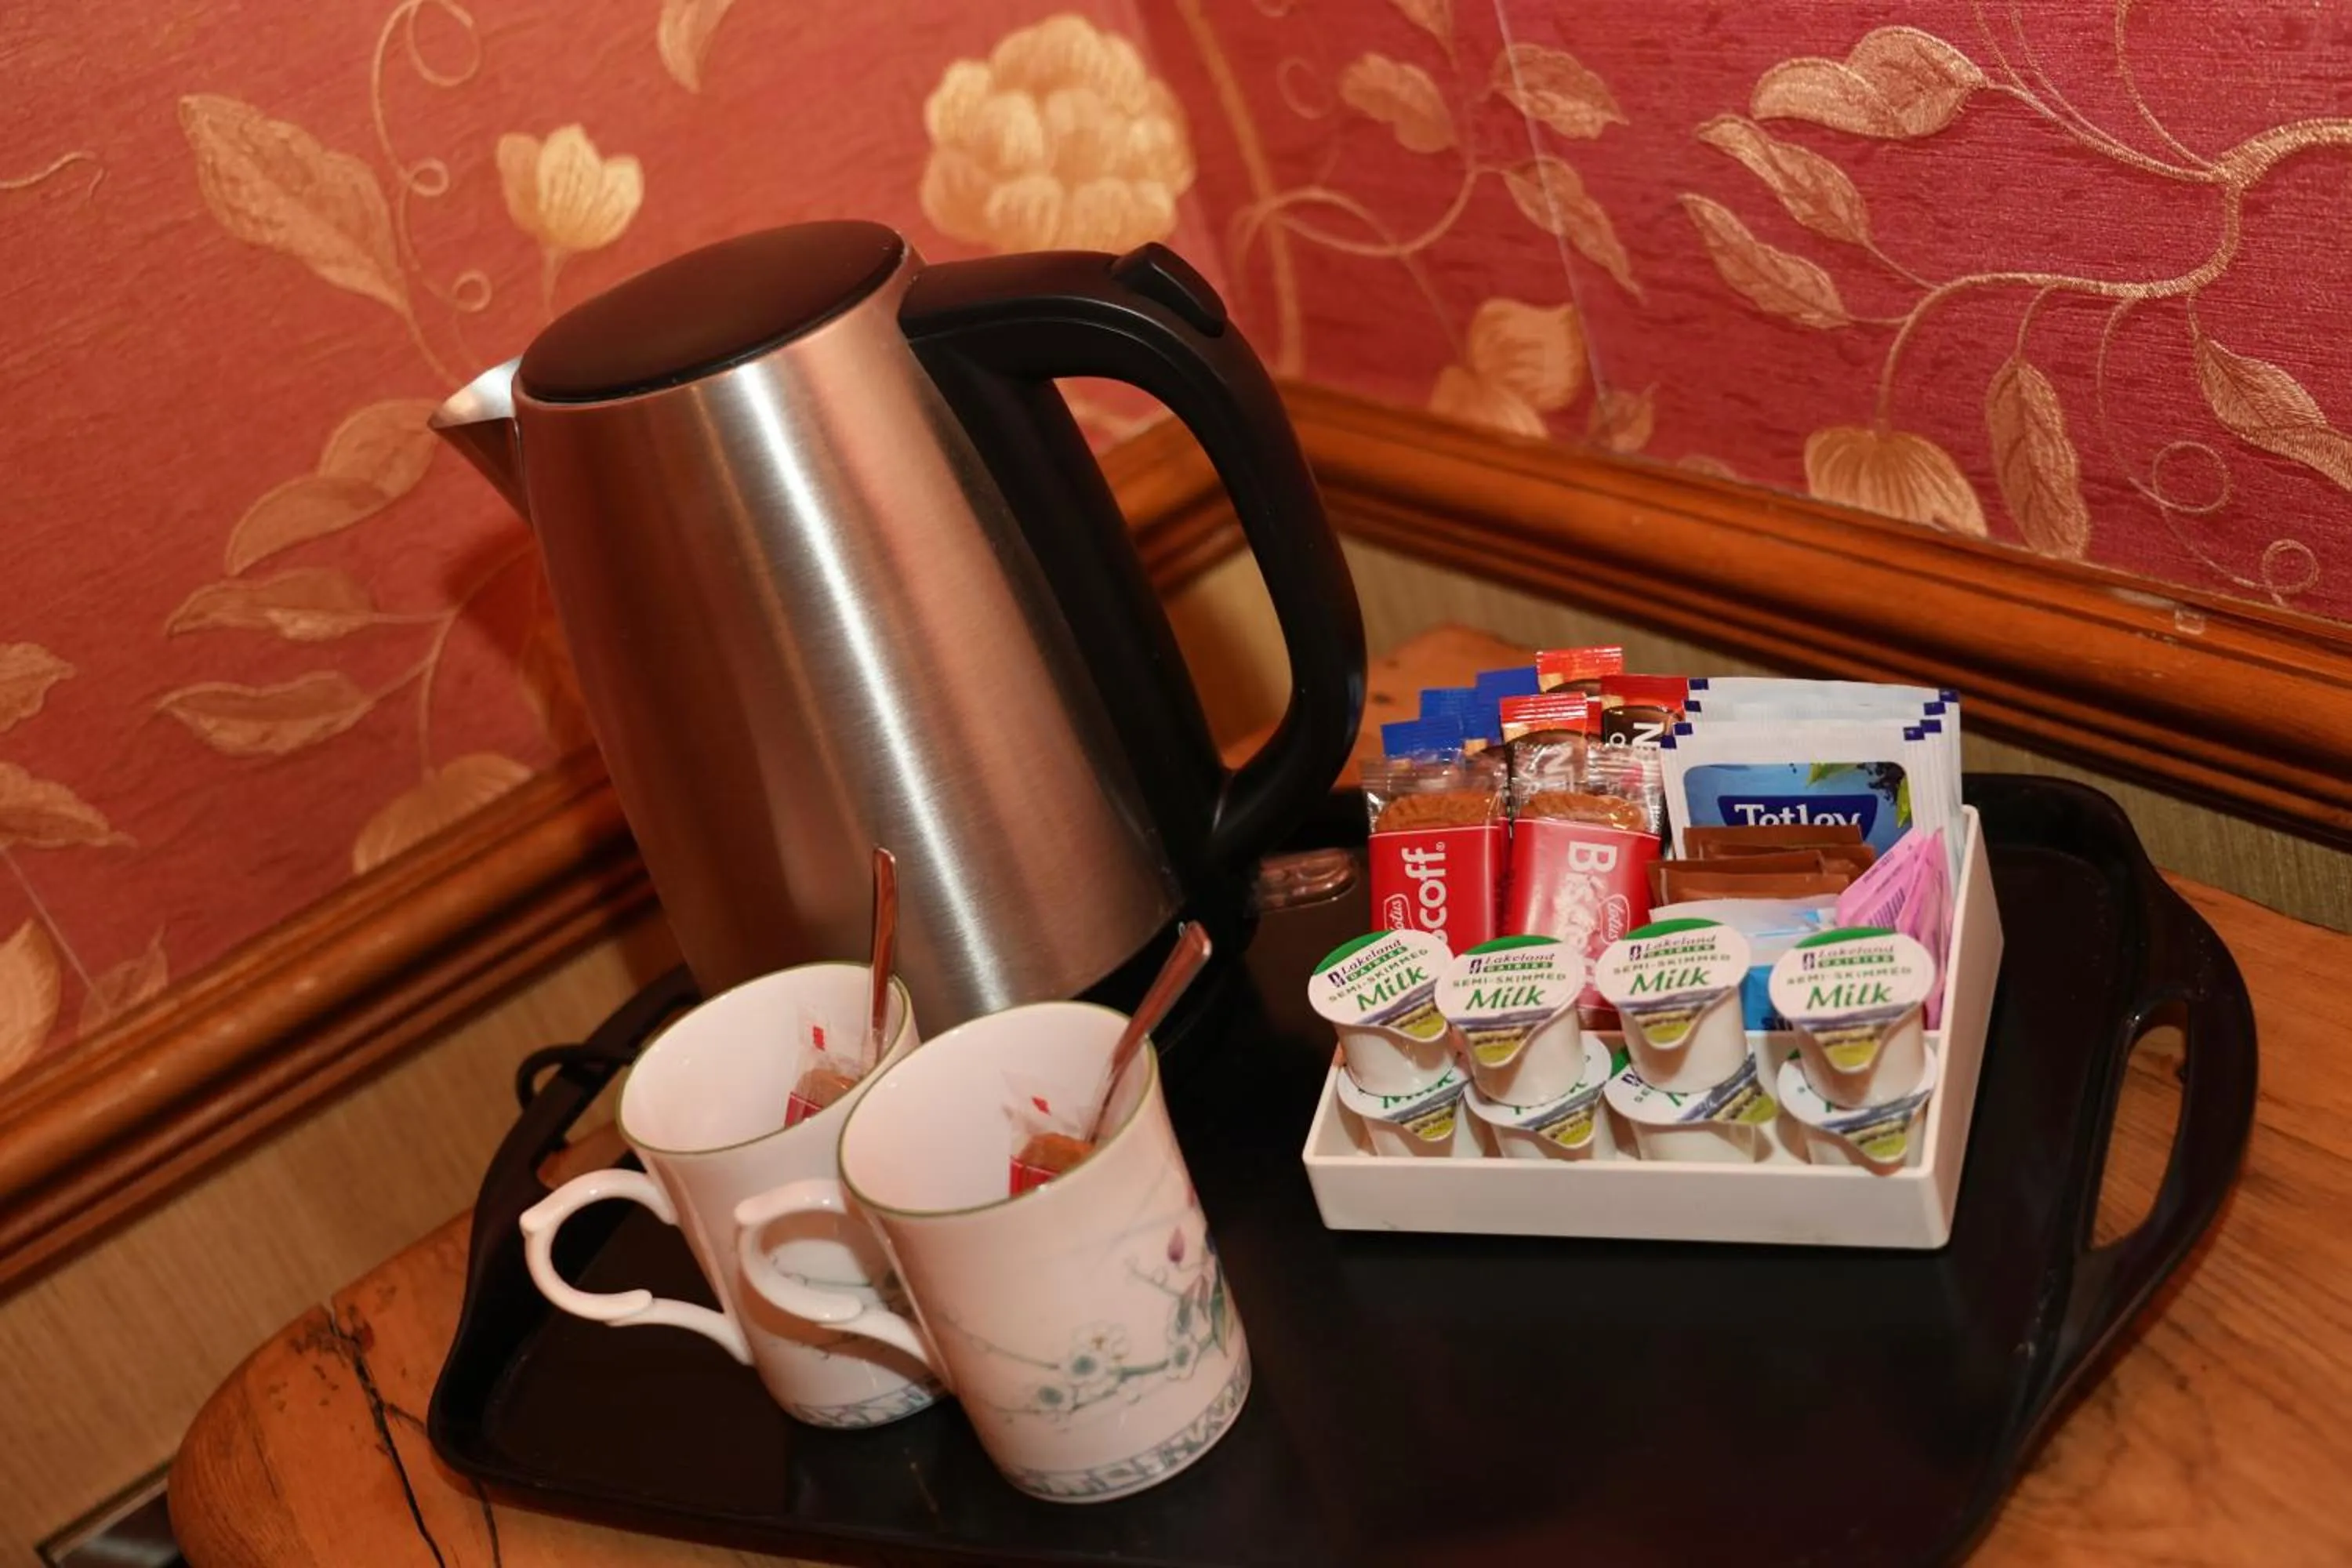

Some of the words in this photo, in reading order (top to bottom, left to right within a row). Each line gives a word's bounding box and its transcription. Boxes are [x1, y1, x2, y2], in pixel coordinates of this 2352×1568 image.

[1401, 848, 1447, 945] coff
[1341, 939, 1402, 975] Lakeland
[1356, 967, 1428, 1011] Milk
[1629, 967, 1711, 995] Milk
[1806, 982, 1893, 1010] Milk
[1465, 985, 1546, 1011] Milk
